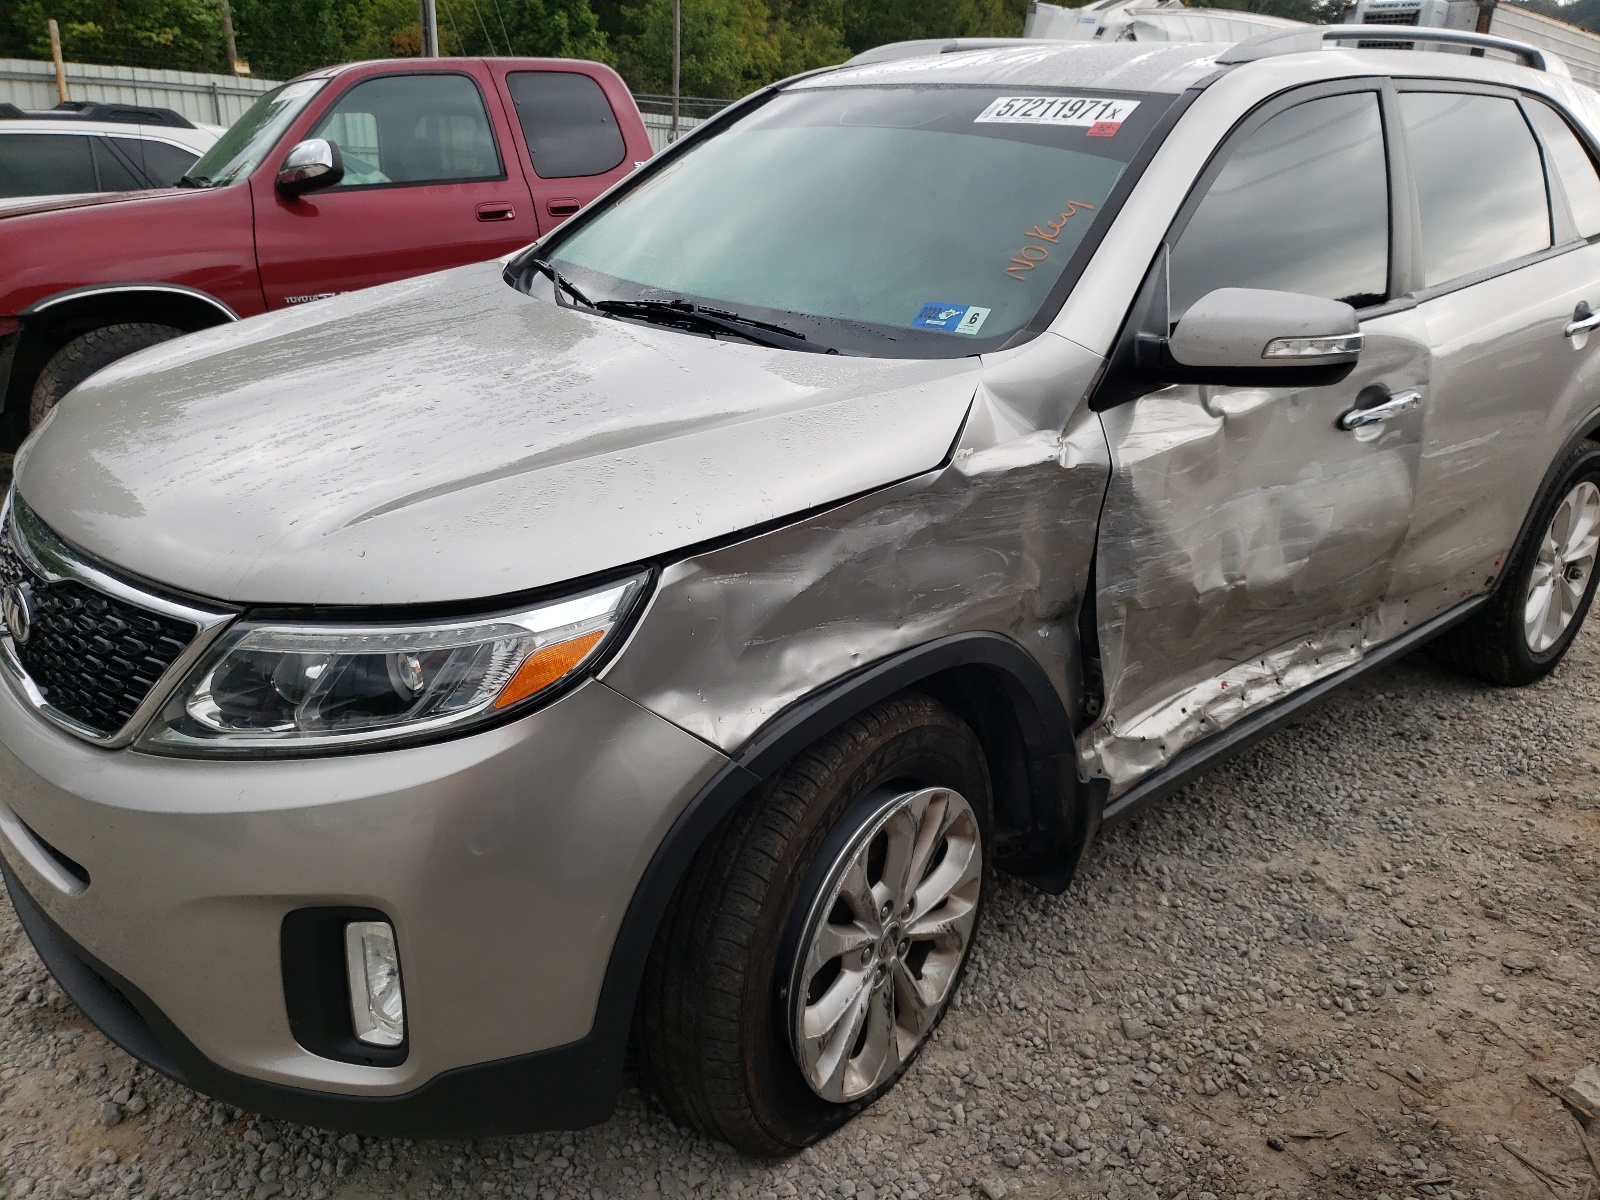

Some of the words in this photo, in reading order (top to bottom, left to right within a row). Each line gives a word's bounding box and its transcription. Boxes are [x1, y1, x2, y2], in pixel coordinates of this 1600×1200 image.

[996, 98, 1114, 121] 57211971
[284, 294, 319, 304] TOYOTA
[968, 312, 980, 325] 6
